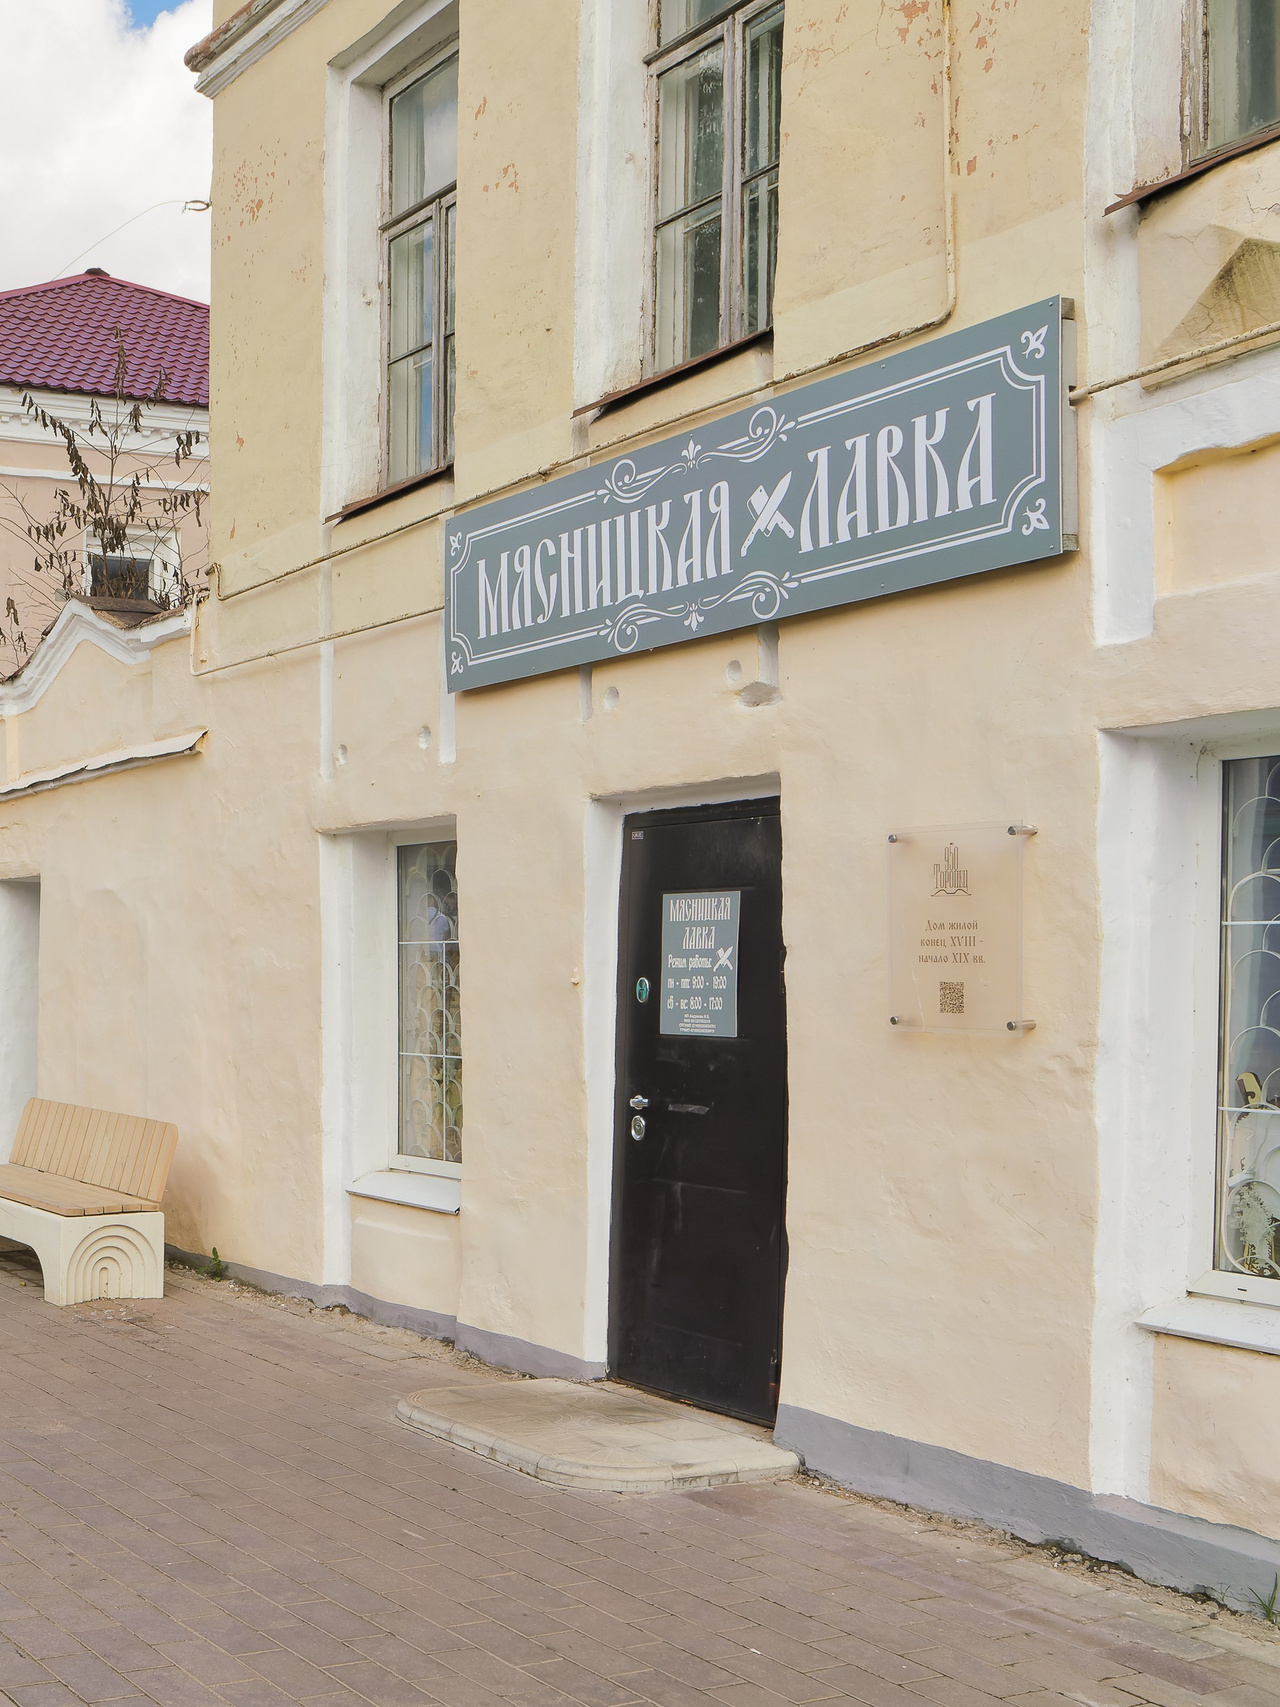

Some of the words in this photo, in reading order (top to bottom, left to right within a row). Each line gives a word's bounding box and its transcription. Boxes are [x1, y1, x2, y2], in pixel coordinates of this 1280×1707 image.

[476, 480, 733, 640] МЯСНИЦКАЯ
[798, 393, 997, 554] ЛАВКА
[944, 844, 959, 871] 950
[670, 897, 731, 922] МЯСНИЦКАЯ
[682, 926, 716, 950] ЛАВКА
[925, 920, 946, 932] Дом
[948, 920, 979, 931] жилой
[920, 939, 947, 948] конец
[950, 936, 976, 947] XVIII
[918, 954, 949, 964] начало
[952, 953, 970, 964] XIX
[973, 956, 986, 964] вв.
